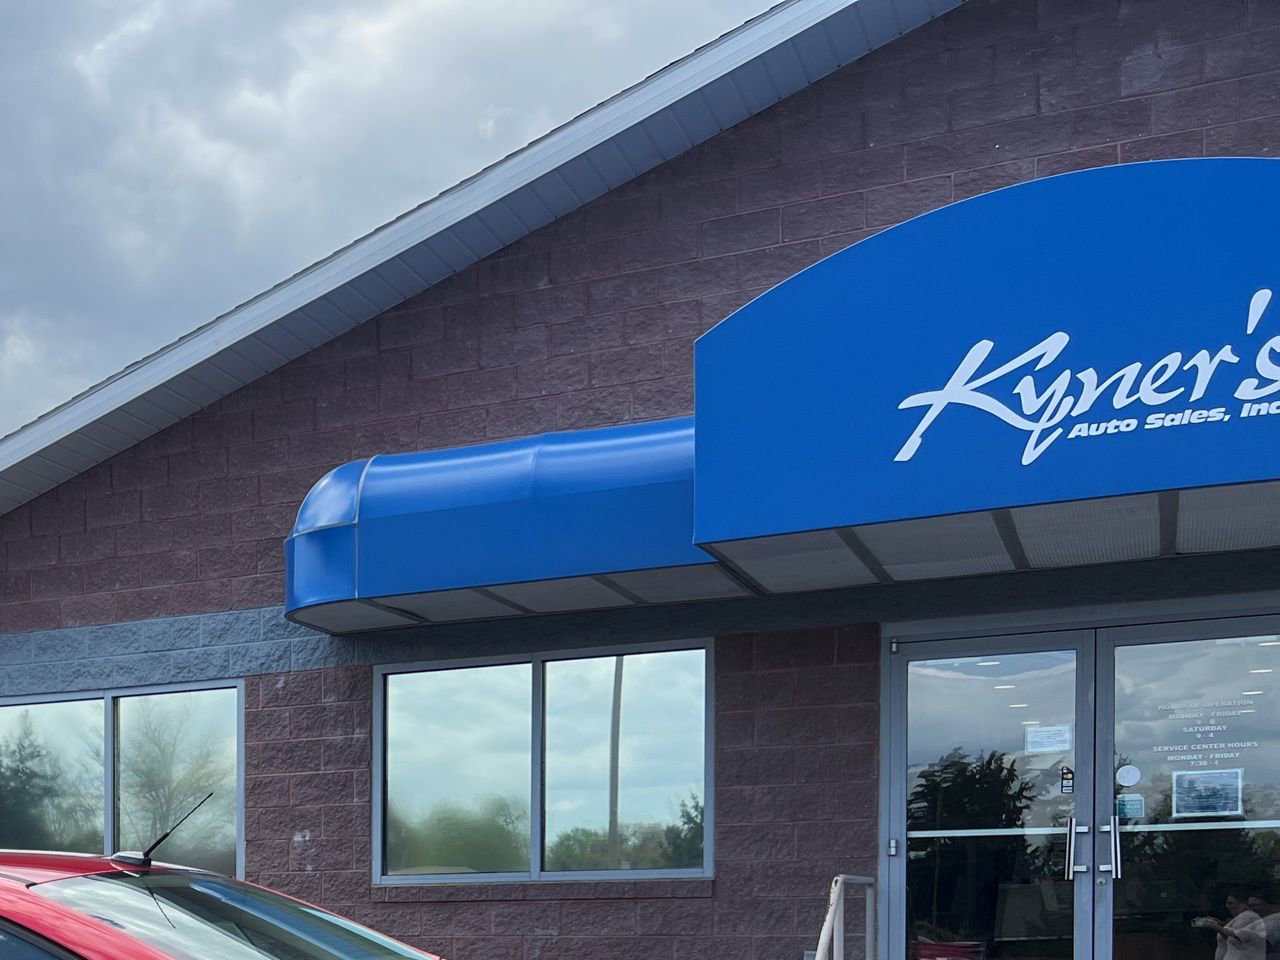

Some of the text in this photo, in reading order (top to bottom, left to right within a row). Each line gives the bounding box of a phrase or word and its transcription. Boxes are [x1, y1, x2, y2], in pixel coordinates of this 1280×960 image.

[894, 288, 1280, 466] Kyner's
[1067, 418, 1139, 439] Auto
[1144, 406, 1232, 428] Sales,
[1168, 712, 1204, 720] MONDAY
[1182, 725, 1228, 733] SATURDAY
[1152, 744, 1189, 752] SERVICE
[1167, 753, 1203, 761] MONDAY
